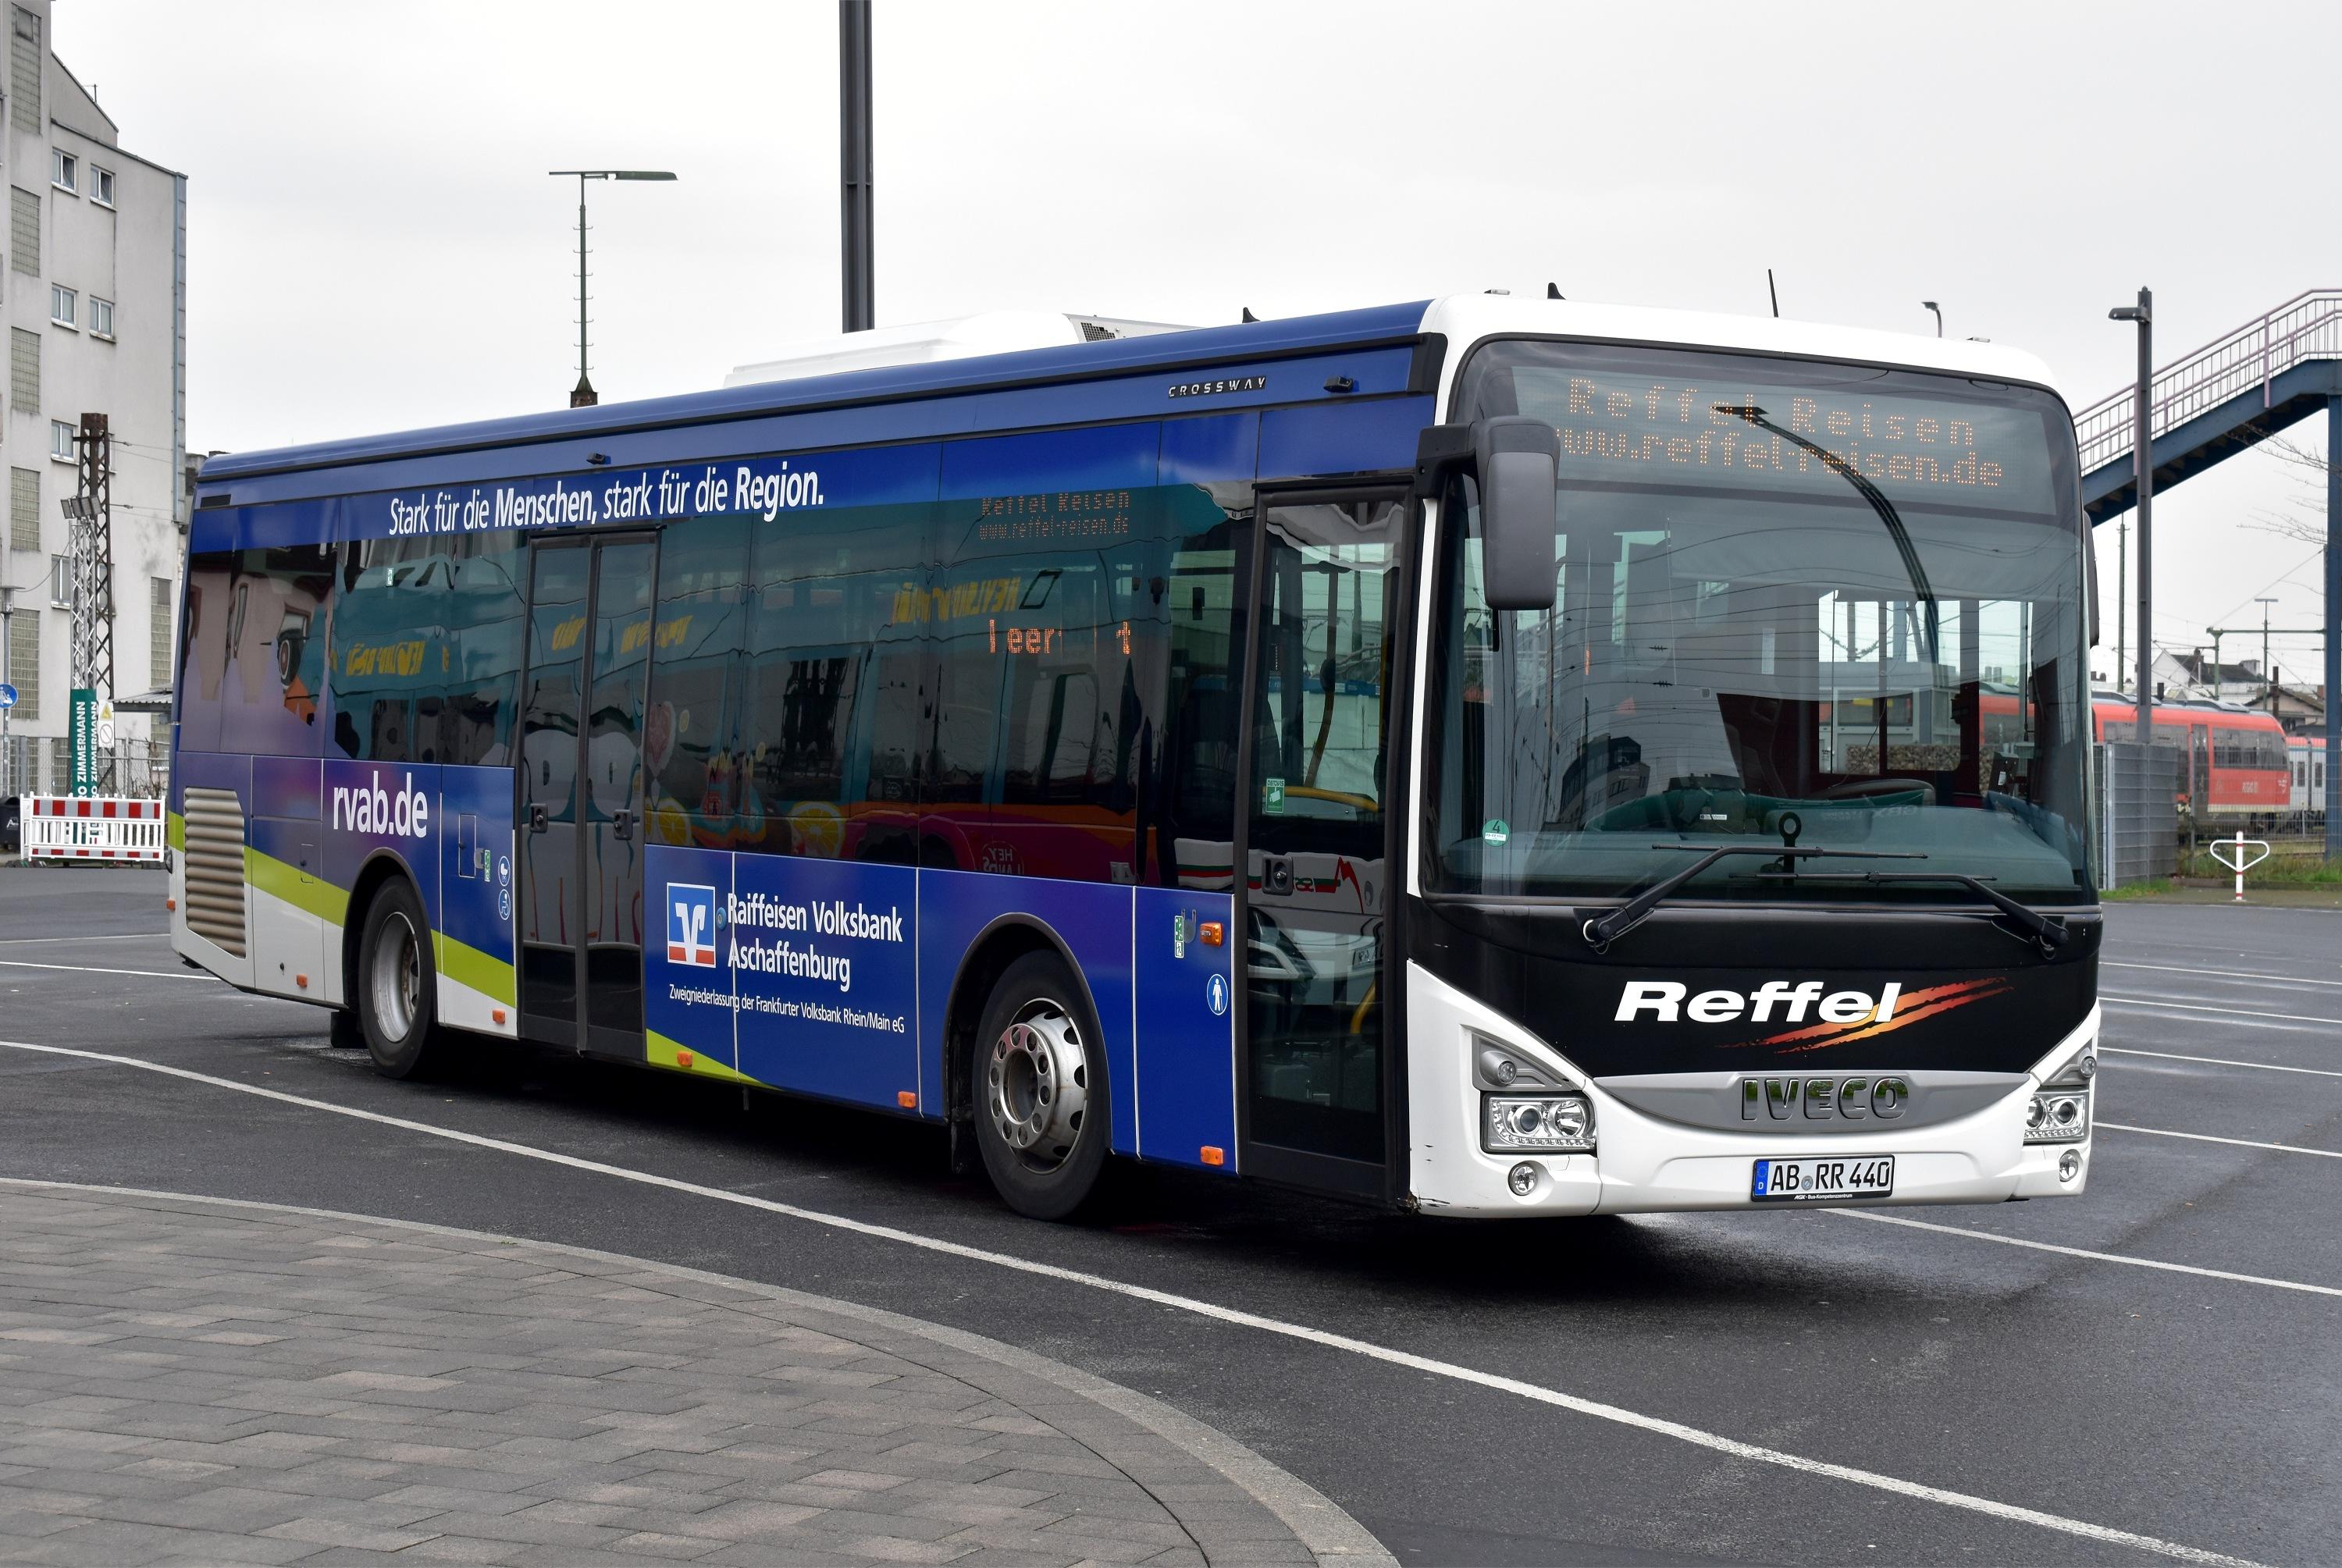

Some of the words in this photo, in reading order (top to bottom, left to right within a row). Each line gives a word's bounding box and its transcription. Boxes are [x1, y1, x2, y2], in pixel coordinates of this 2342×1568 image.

[1168, 377, 1265, 397] CROSSWAY
[1570, 379, 1756, 428] Reffel
[1792, 397, 1973, 446] Reisen
[1556, 429, 2003, 485] ww.reffel-reisen.de
[389, 493, 430, 535] Stark
[434, 491, 460, 532] für
[463, 489, 489, 530] die
[494, 480, 597, 528] Menschen,
[603, 471, 653, 520] stark
[659, 469, 690, 515] für
[695, 467, 728, 513] die
[735, 460, 824, 522] Region.
[980, 511, 1129, 540] www.reffel-reisen.de
[76, 701, 87, 783] ZIMMERMANN
[333, 770, 428, 837] rvab.de
[728, 892, 806, 931] Raiffeisen
[812, 900, 902, 942] Volksbank
[728, 937, 850, 993] Aschaffenburg
[669, 983, 739, 1012] Zweigniederlassung
[742, 993, 754, 1011] der
[756, 995, 799, 1017] Frankfurter
[800, 1001, 842, 1024] Volksbank
[843, 1008, 891, 1031] Rhein/Main
[892, 1016, 904, 1033] eG
[1614, 980, 1902, 1023] Reffel
[1741, 1076, 1910, 1121] IVECO
[1758, 1182, 1764, 1190] D
[1770, 1164, 1800, 1191] AB
[1815, 1163, 1845, 1189] RR
[1849, 1161, 1890, 1188] 440
